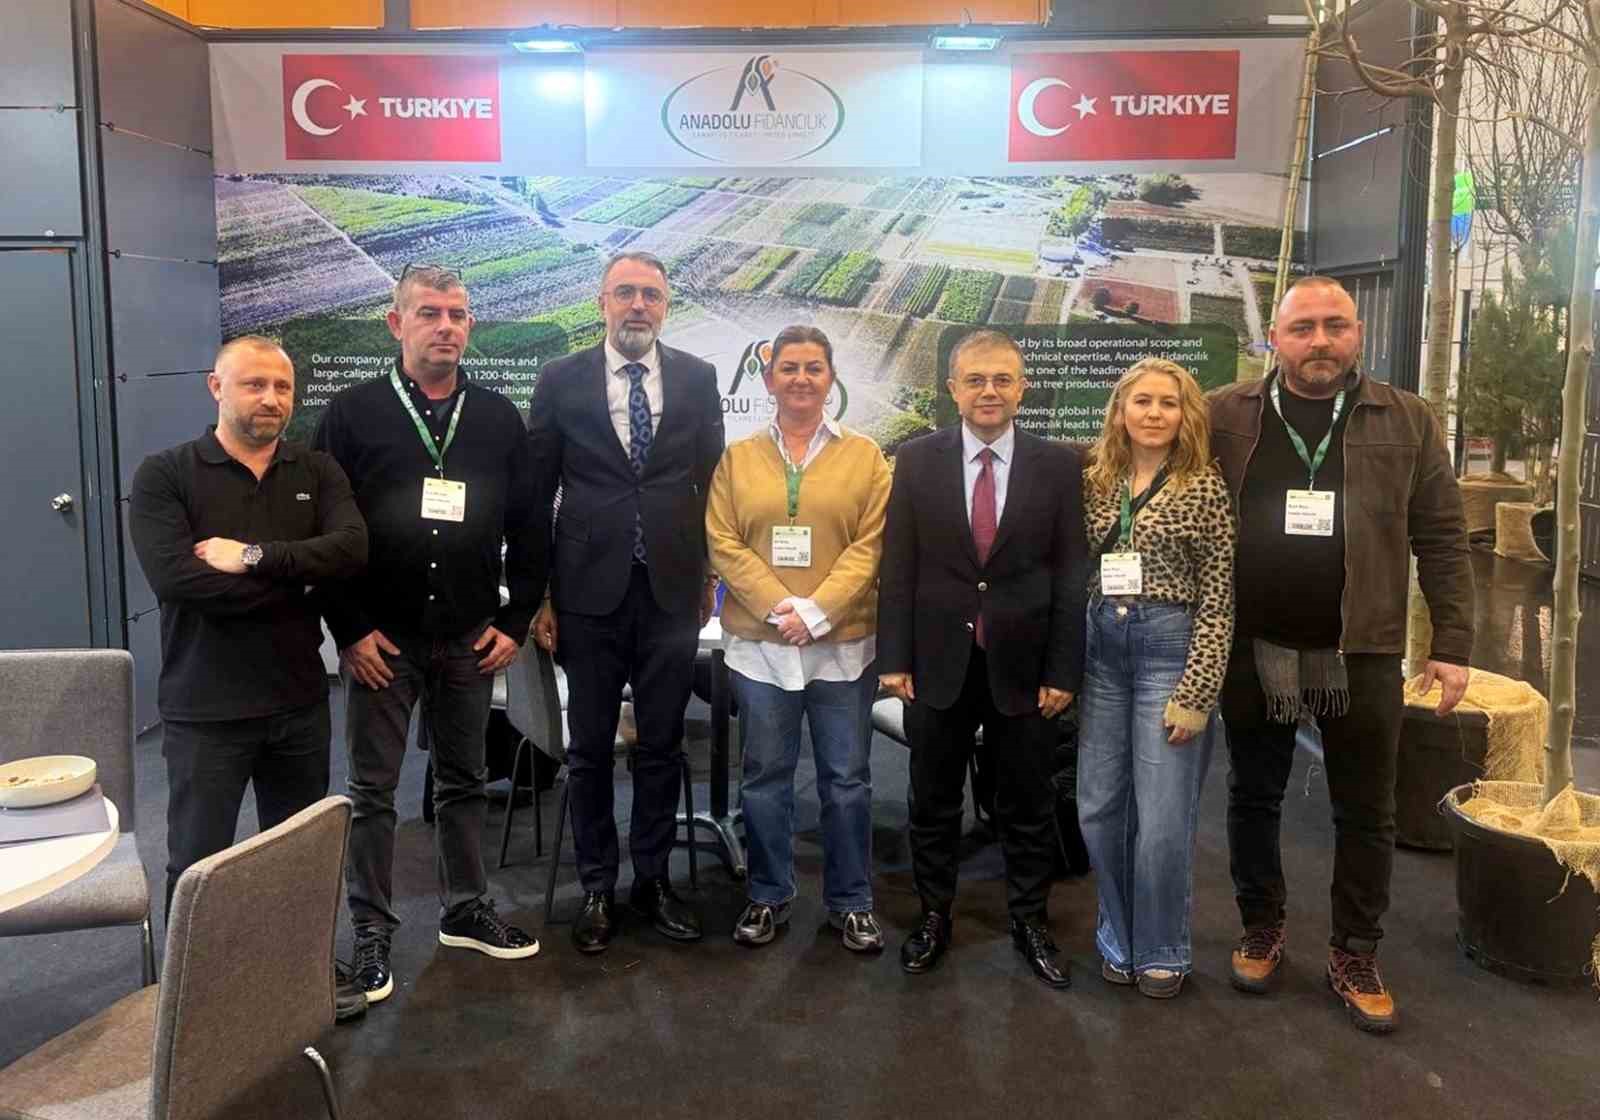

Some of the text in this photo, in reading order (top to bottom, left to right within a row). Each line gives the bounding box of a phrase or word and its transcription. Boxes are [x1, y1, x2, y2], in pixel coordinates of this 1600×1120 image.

[679, 113, 751, 129] ANADOLU
[1028, 338, 1039, 350] by
[1042, 338, 1054, 348] its
[1056, 338, 1087, 348] broad
[1089, 338, 1148, 350] operational
[1150, 340, 1180, 350] scope
[1182, 338, 1203, 348] and
[311, 353, 331, 364] Our
[334, 355, 382, 367] company
[490, 357, 515, 366] trees
[517, 356, 538, 366] and
[1024, 352, 1061, 361] echnical
[1063, 353, 1112, 363] expertise,
[313, 368, 378, 380] large-caliper
[474, 370, 537, 380] 1200-decare
[1036, 367, 1056, 375] one
[1057, 365, 1069, 375] of
[1071, 365, 1088, 375] the
[1043, 380, 1065, 389] tree
[1065, 379, 1116, 391] productio
[1057, 405, 1089, 418] global
[1064, 419, 1090, 429] leads
